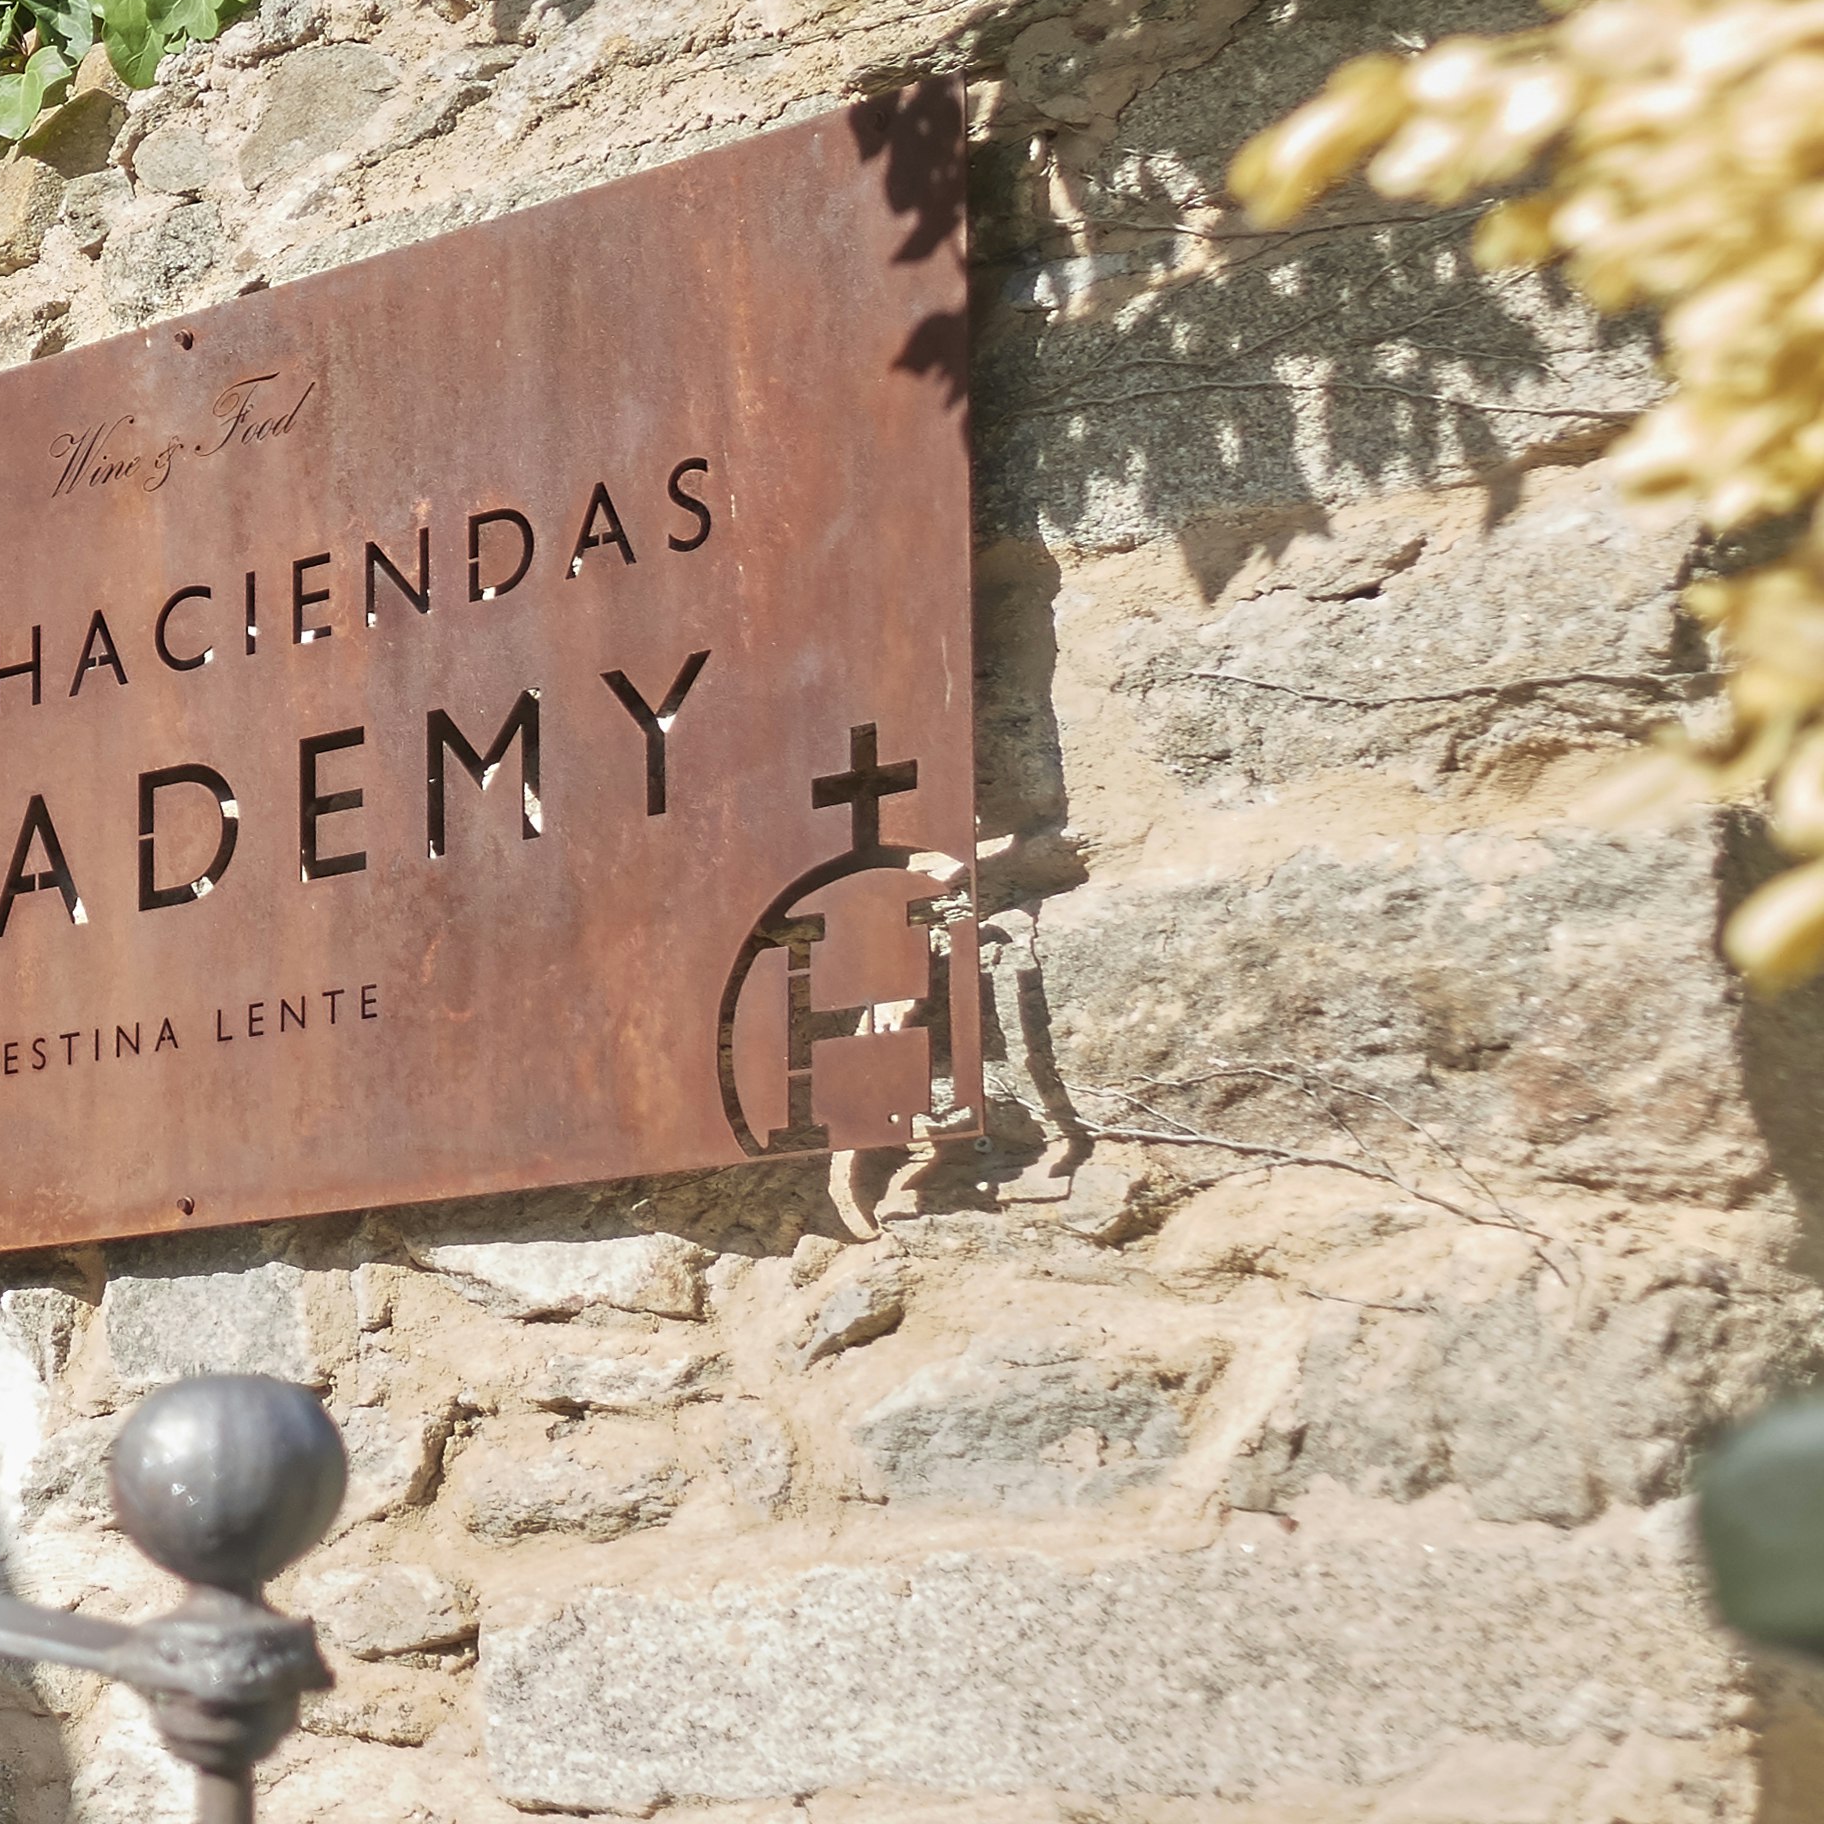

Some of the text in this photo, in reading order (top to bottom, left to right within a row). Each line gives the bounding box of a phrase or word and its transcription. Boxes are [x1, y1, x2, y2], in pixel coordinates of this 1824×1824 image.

[49, 371, 316, 498] Wine & Food
[216, 983, 379, 1043] LENTE
